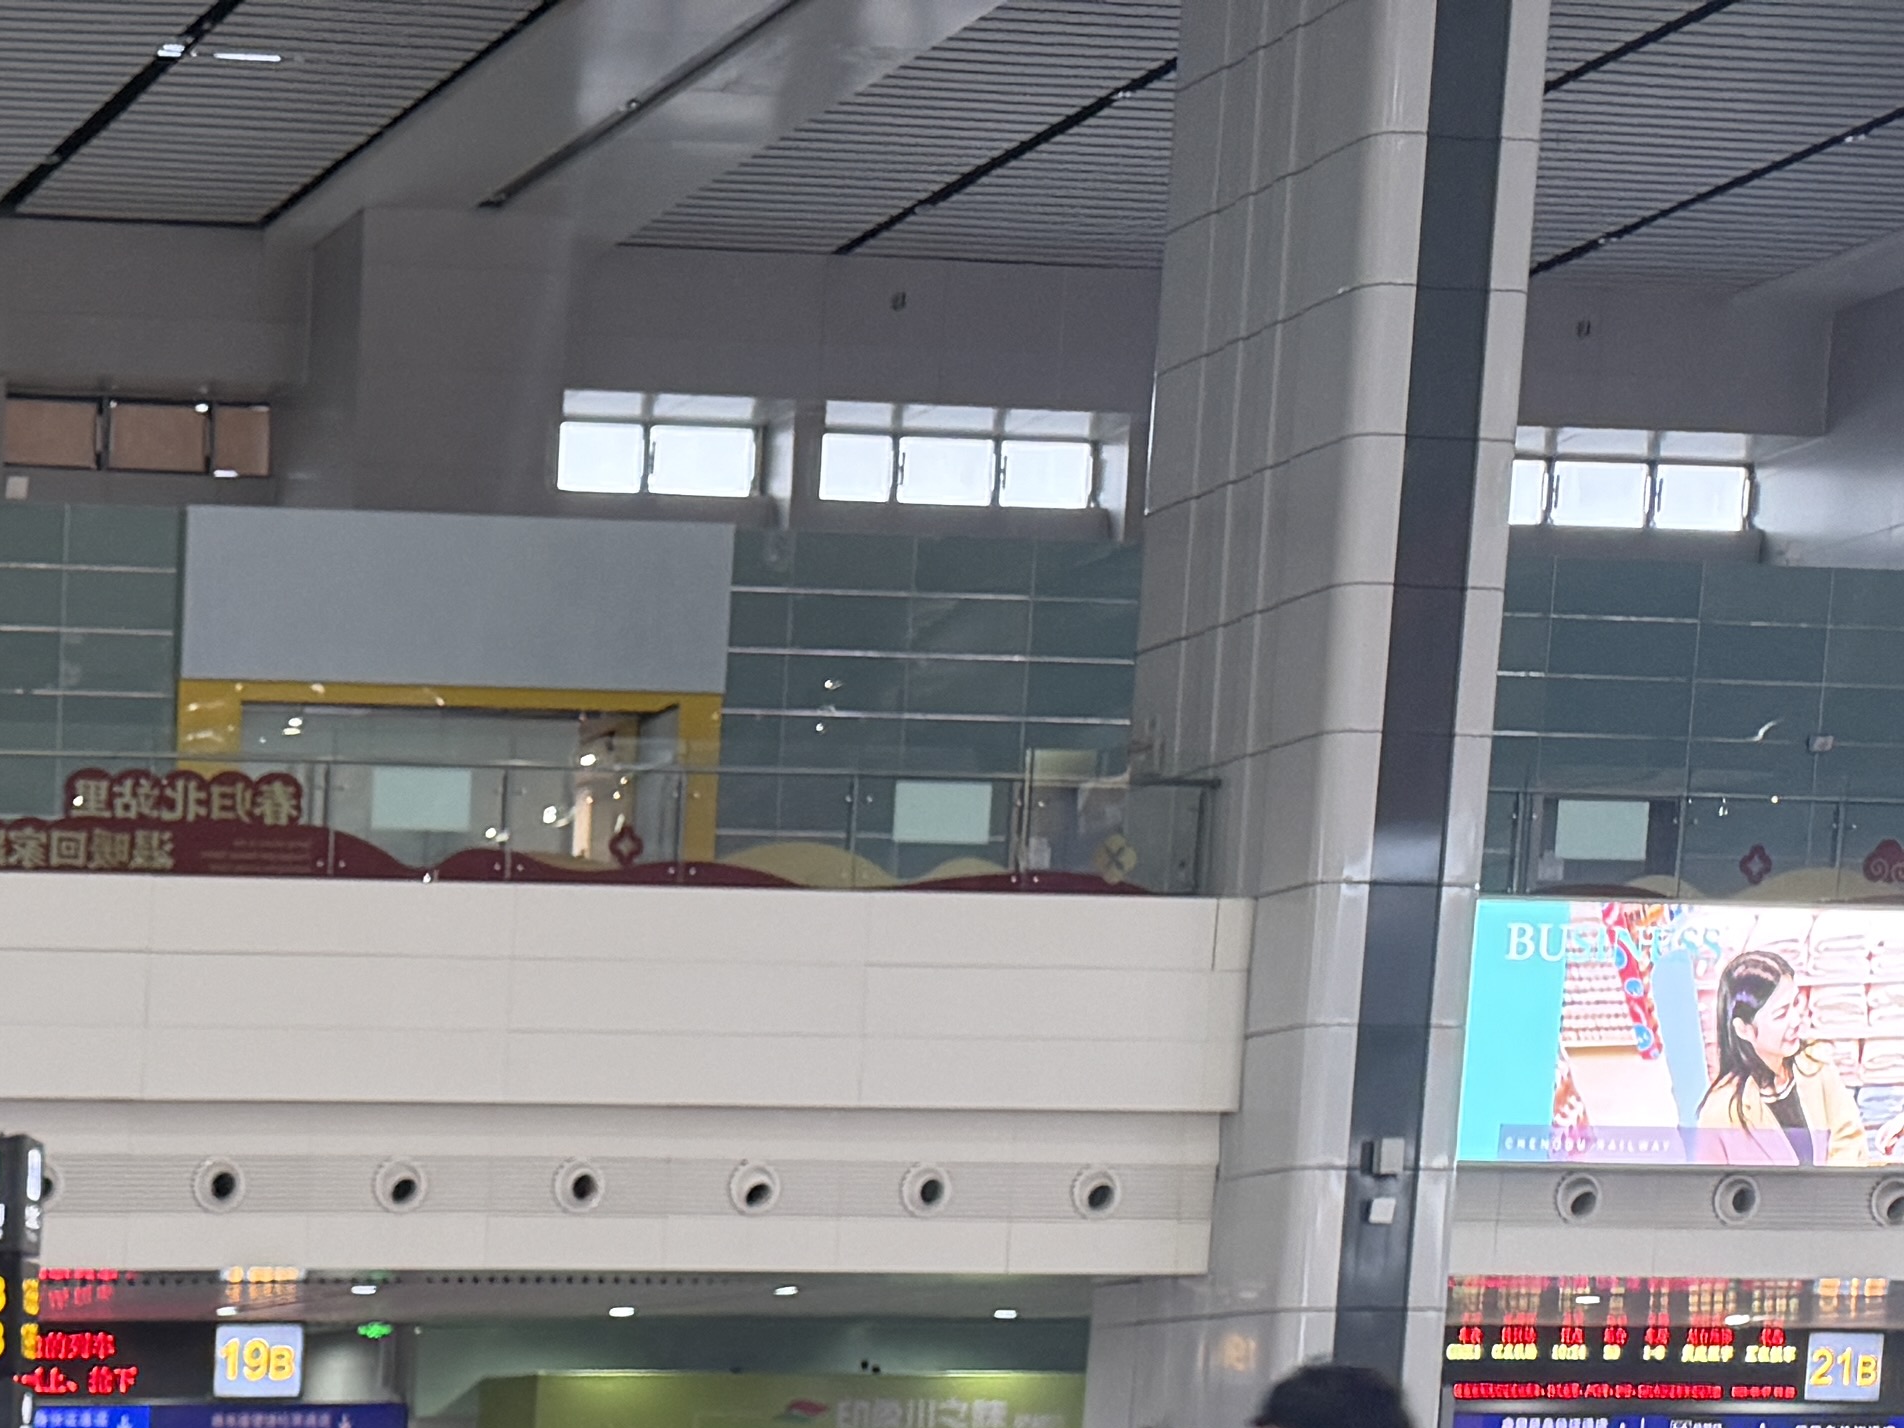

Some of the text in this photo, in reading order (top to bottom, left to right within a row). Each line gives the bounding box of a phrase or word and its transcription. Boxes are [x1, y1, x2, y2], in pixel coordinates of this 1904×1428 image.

[1504, 921, 1722, 964] BUSINESS
[1504, 1136, 1672, 1154] CHENGDU RAILWAY
[220, 1336, 296, 1382] 19B
[1809, 1346, 1879, 1387] 21B
